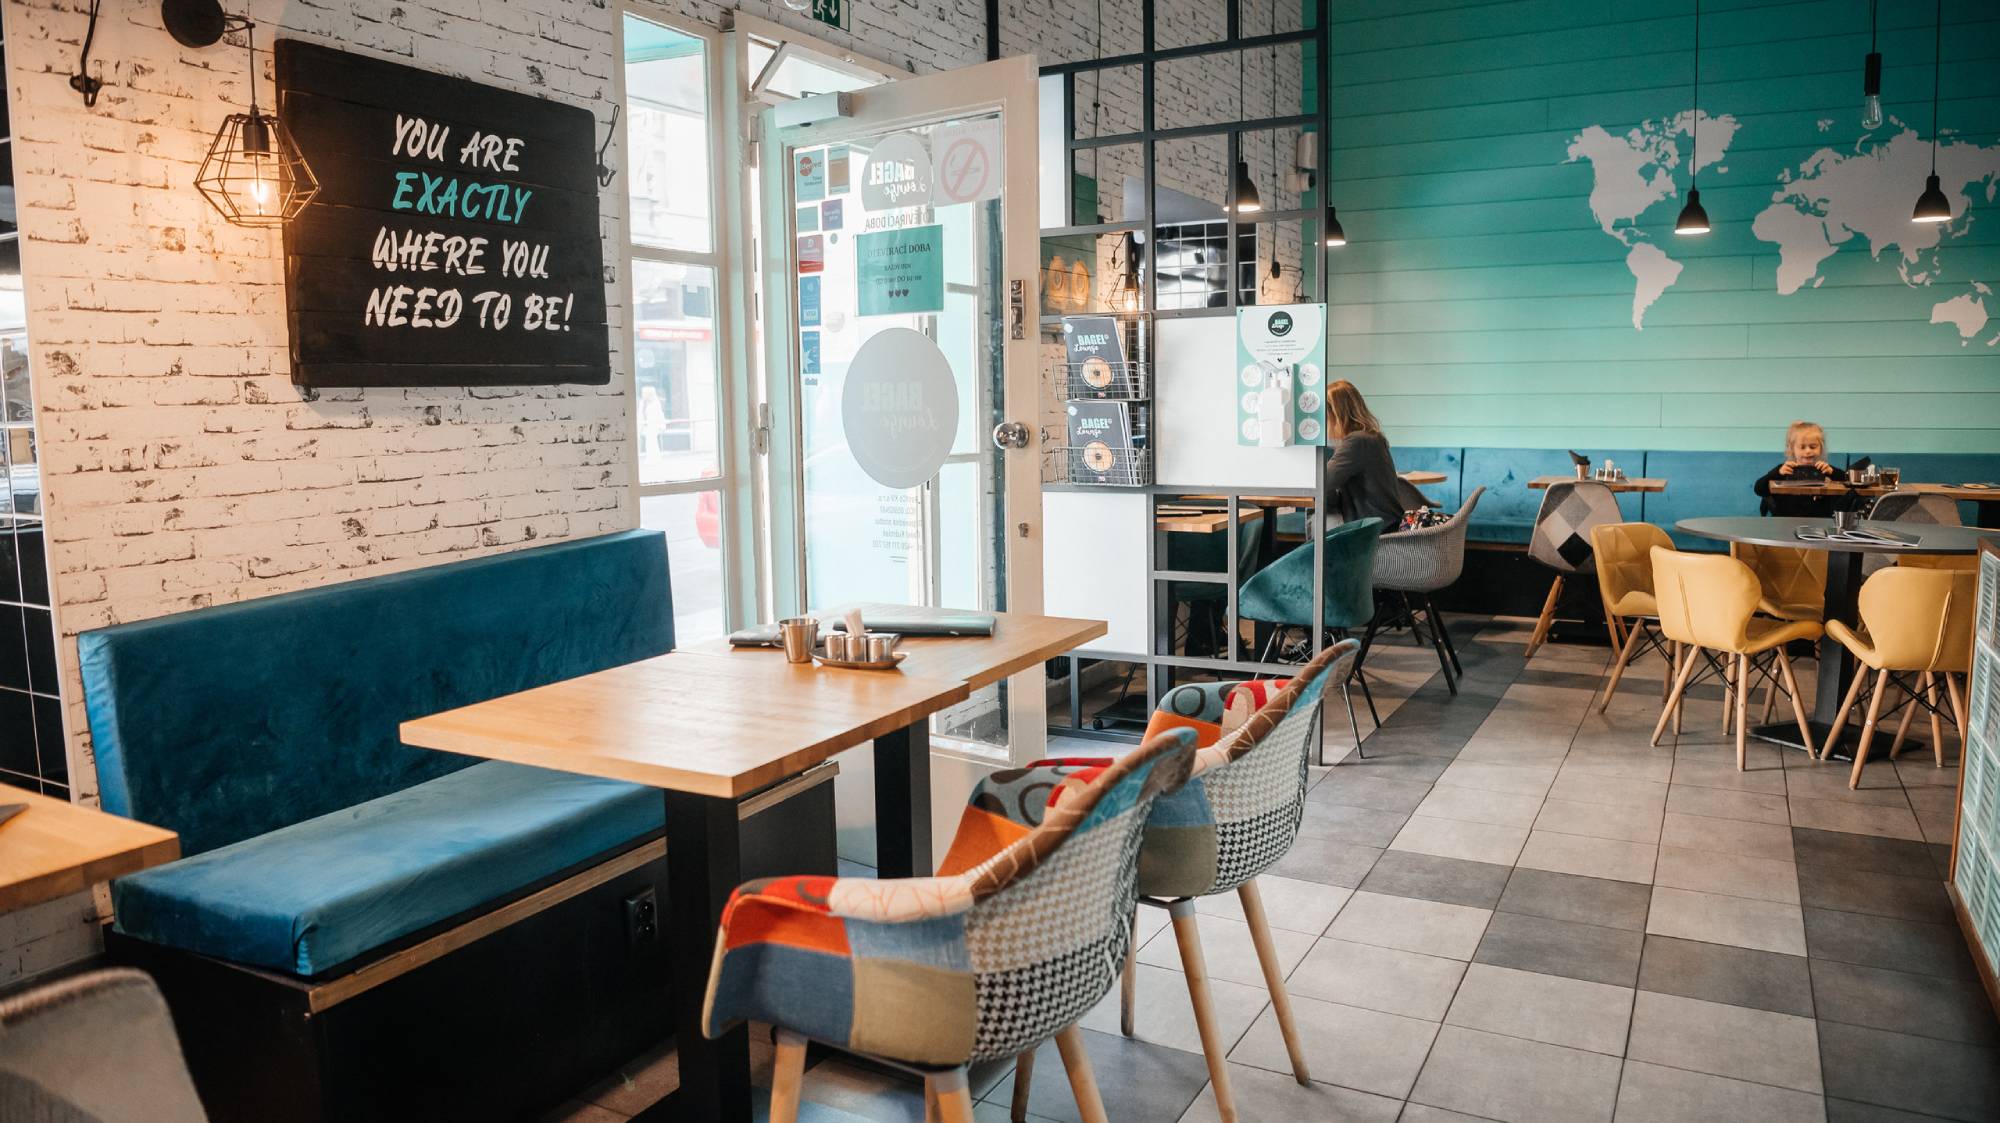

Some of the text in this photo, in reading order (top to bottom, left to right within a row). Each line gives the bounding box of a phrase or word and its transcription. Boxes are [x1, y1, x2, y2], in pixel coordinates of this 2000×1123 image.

[392, 114, 525, 172] YOU ARE
[392, 171, 532, 224] EXACTLY
[372, 226, 550, 279] WHERE YOU
[908, 242, 931, 254] DOBA
[365, 284, 574, 332] NEED TO BE!
